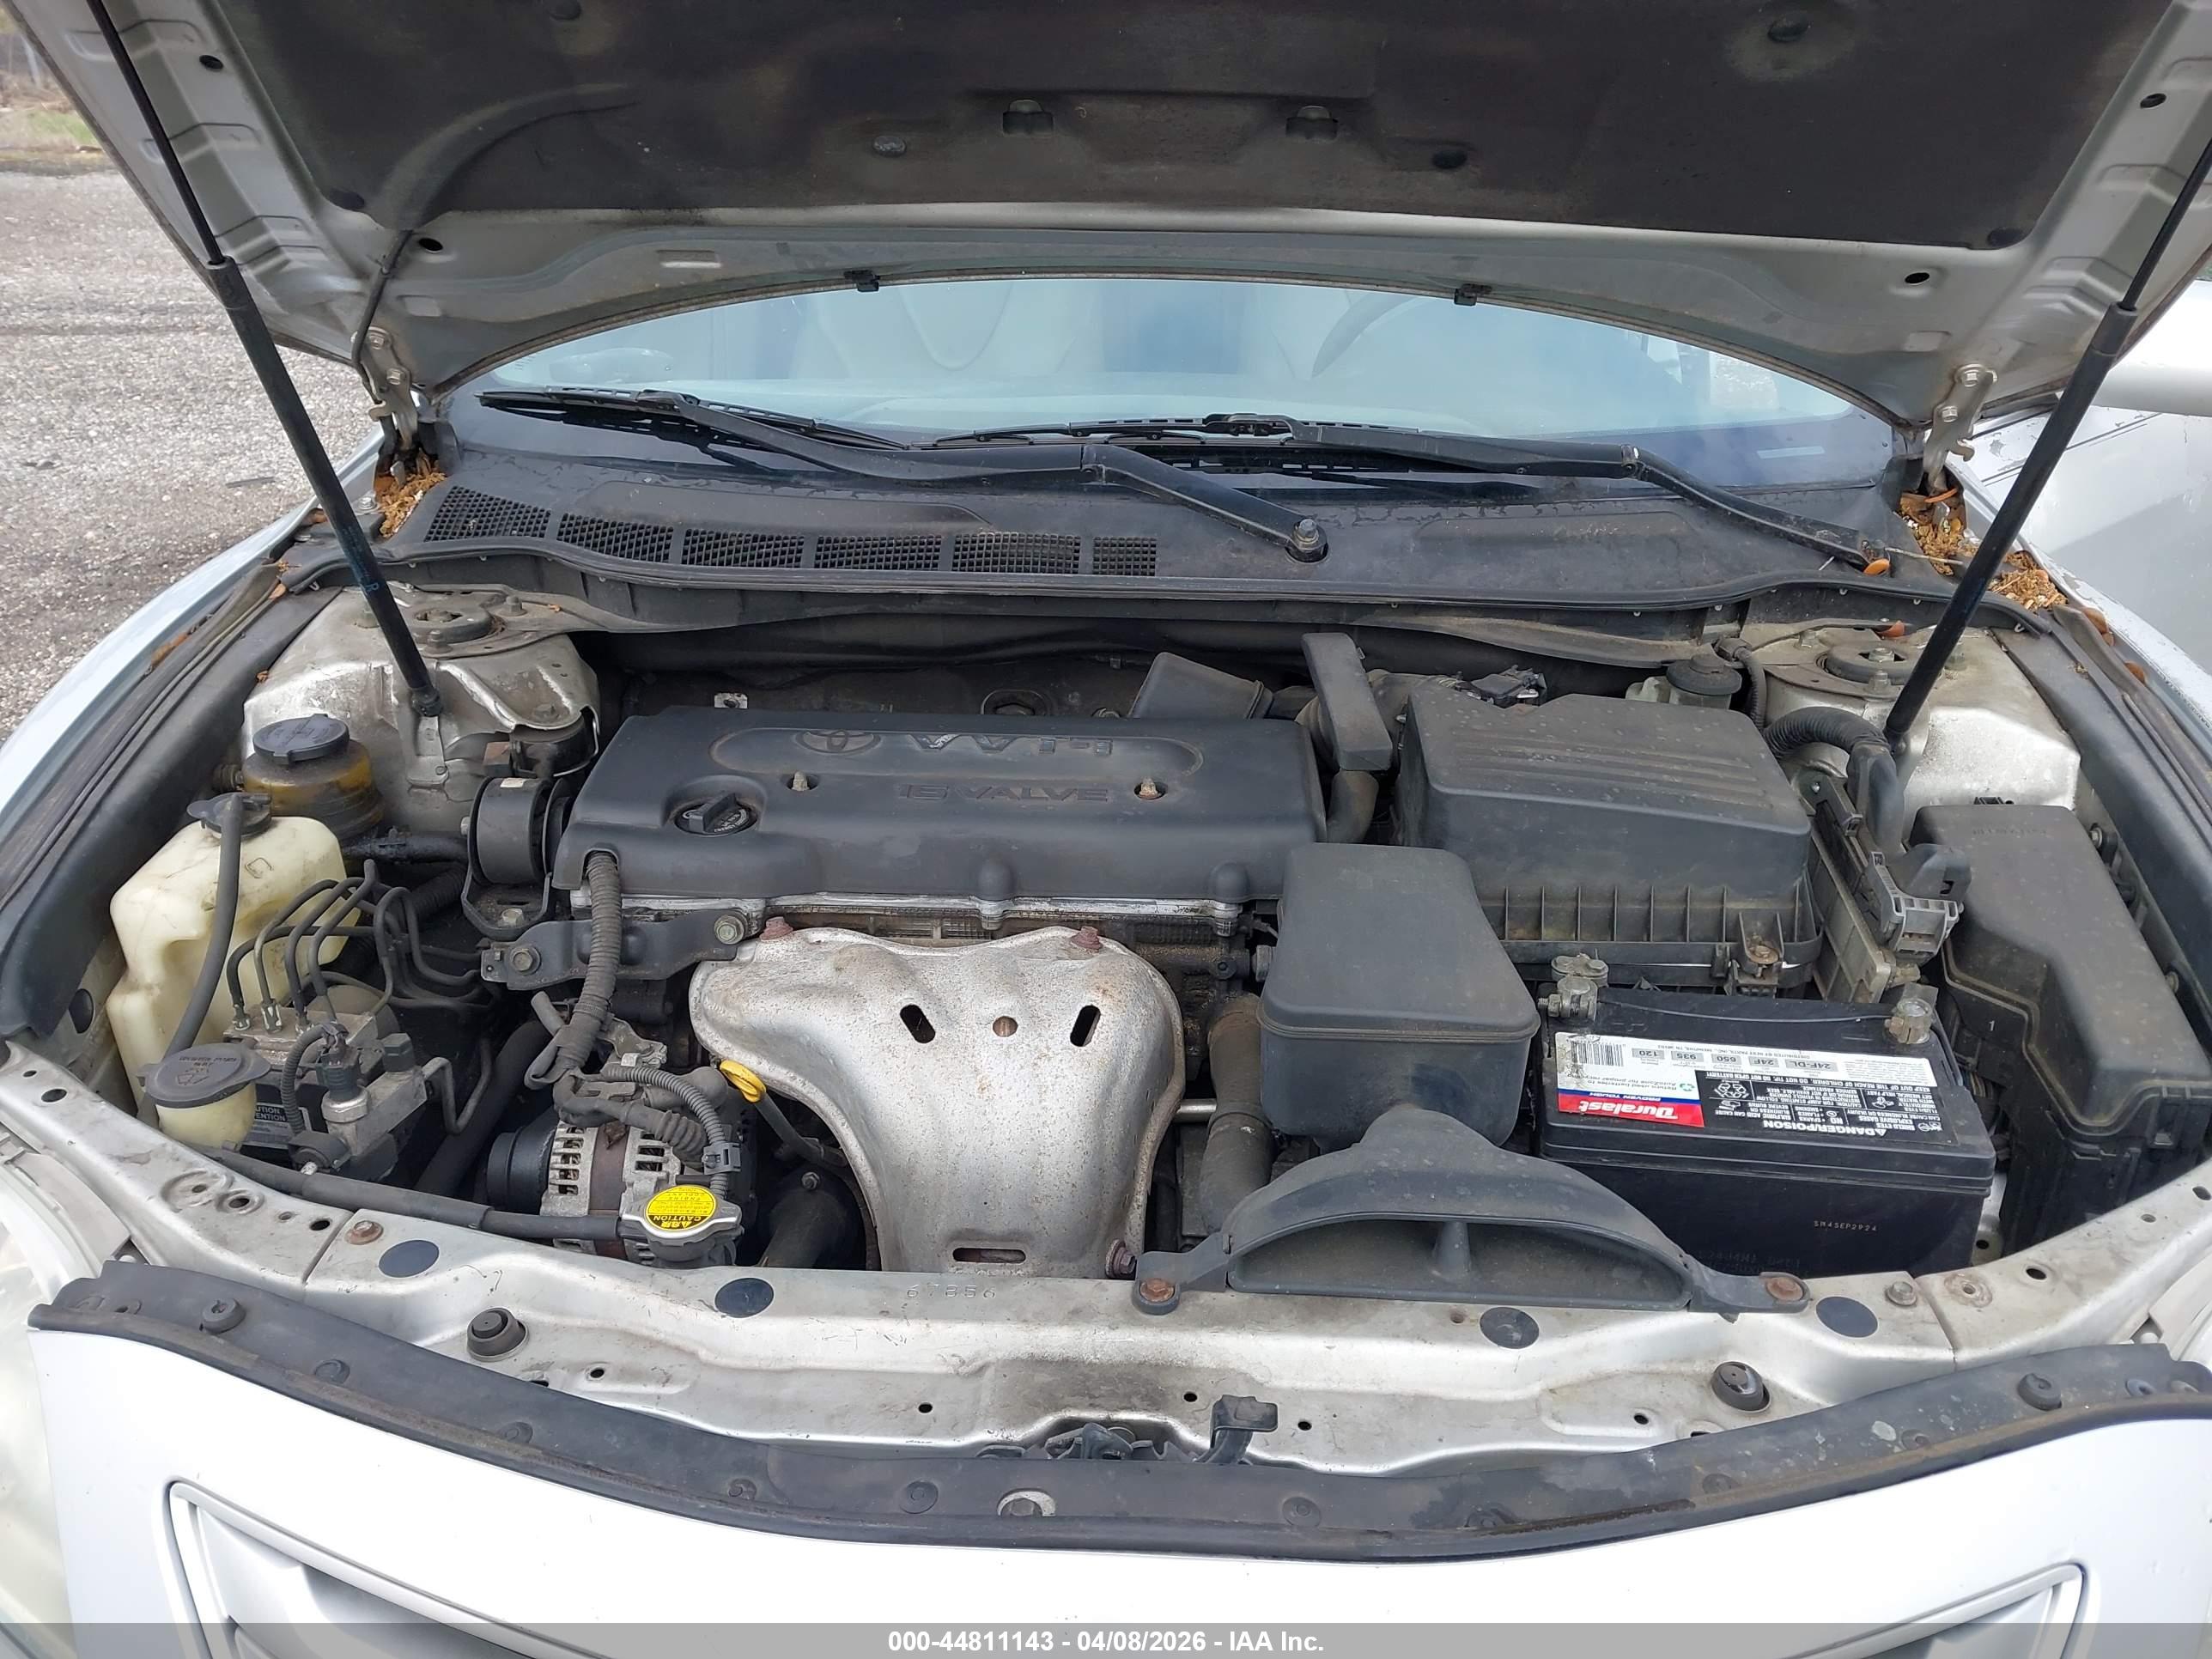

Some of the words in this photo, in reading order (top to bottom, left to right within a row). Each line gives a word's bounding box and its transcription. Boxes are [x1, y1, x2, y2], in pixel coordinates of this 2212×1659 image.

[954, 784, 1109, 803] VALVE
[256, 1106, 280, 1114] UTION
[256, 1112, 286, 1121] ENTION
[1578, 1100, 1678, 1120] Duralast
[1763, 1120, 1875, 1135] DANGER/POISON
[906, 1284, 996, 1298] 67856
